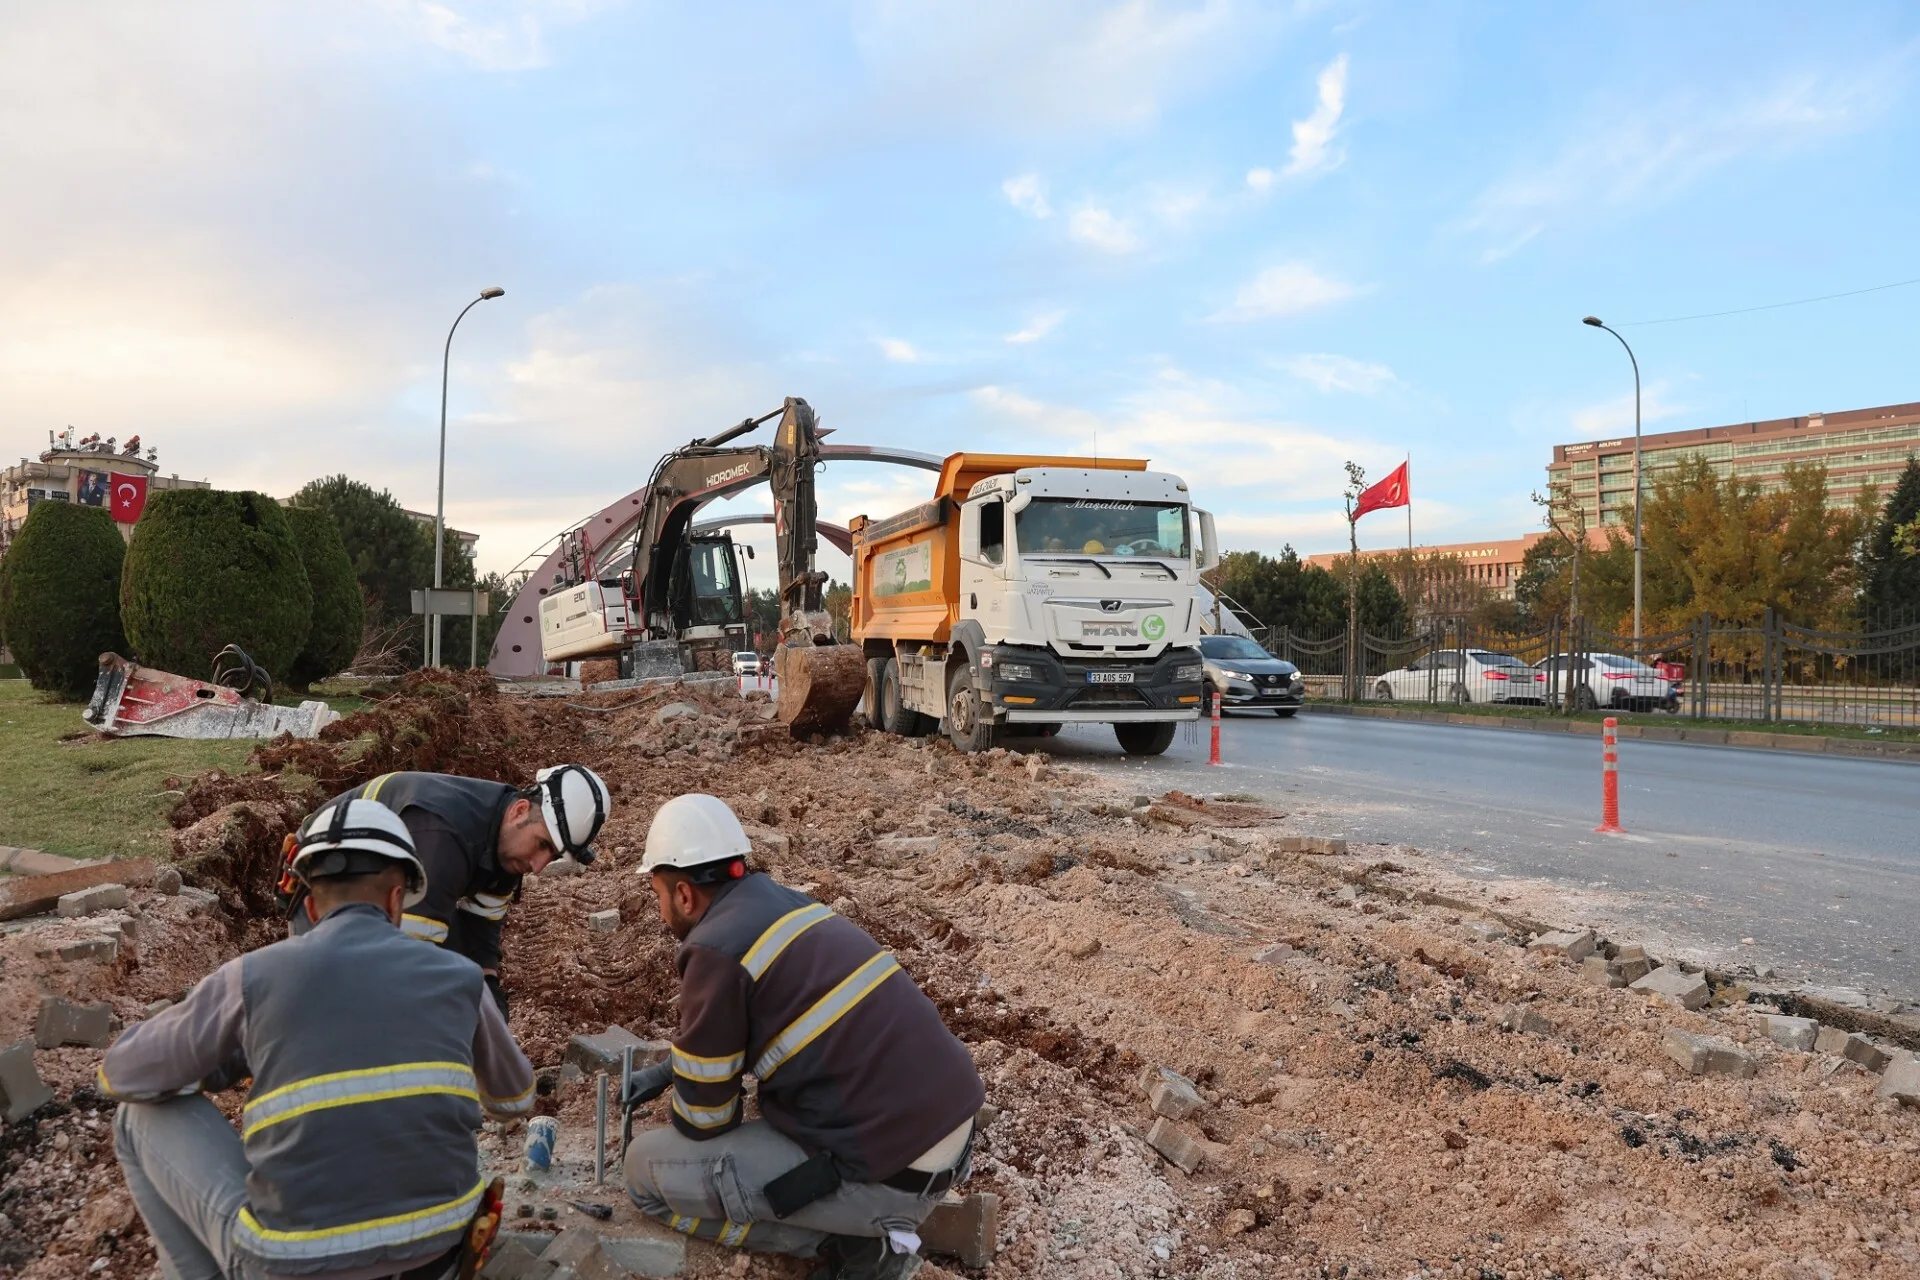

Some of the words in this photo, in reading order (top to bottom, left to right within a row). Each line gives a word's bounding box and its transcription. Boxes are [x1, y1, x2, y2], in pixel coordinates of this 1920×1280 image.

[1456, 548, 1499, 559] SARAYI
[574, 591, 586, 603] 210
[1082, 624, 1138, 637] MAN
[1092, 673, 1101, 682] 33
